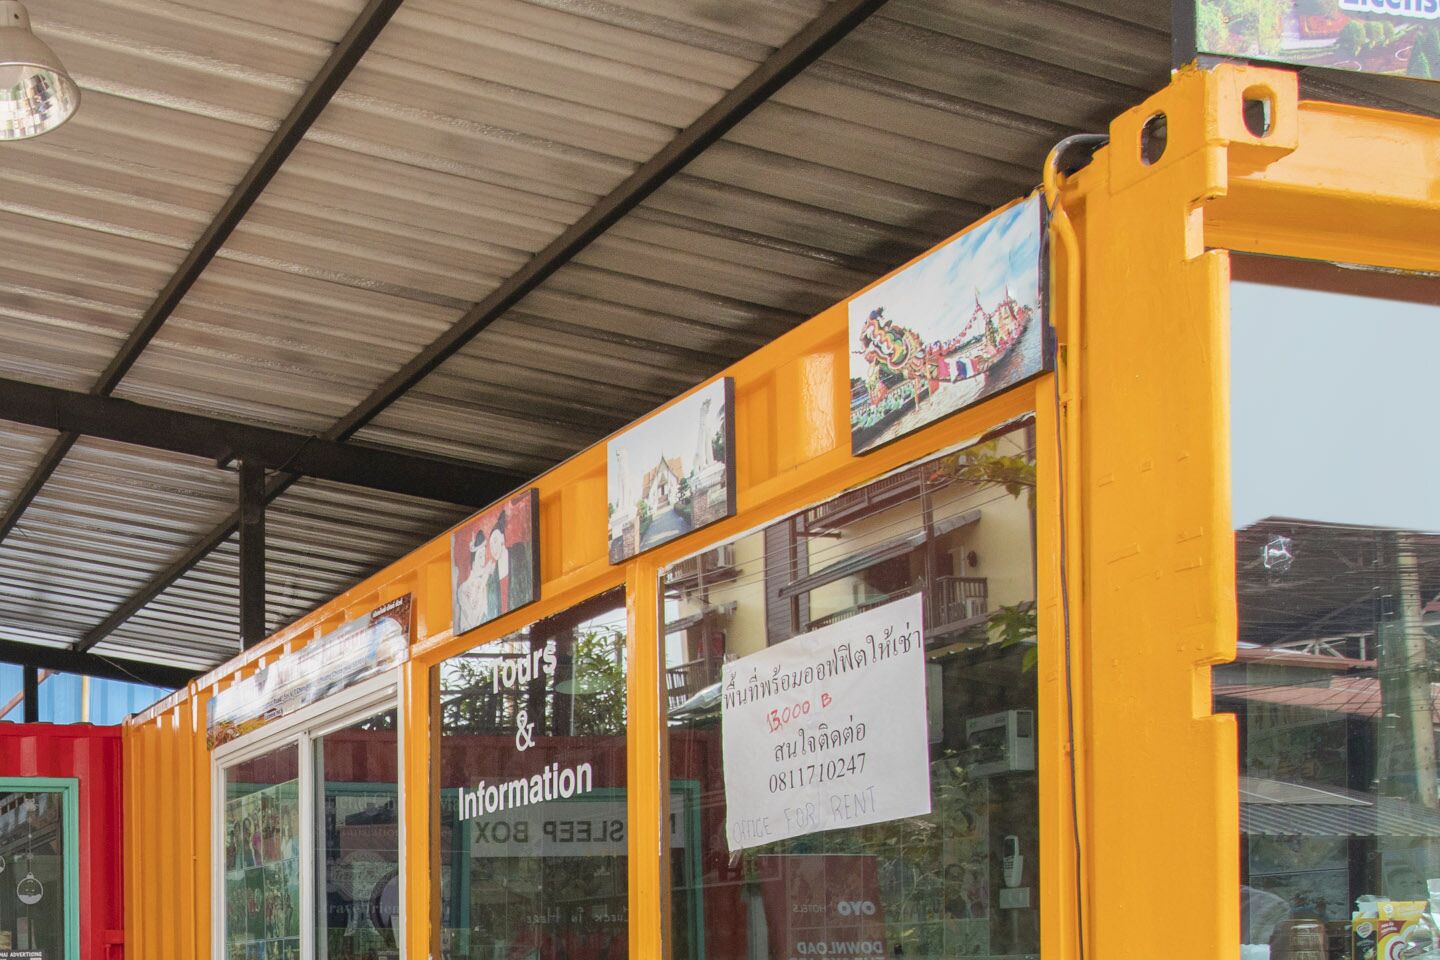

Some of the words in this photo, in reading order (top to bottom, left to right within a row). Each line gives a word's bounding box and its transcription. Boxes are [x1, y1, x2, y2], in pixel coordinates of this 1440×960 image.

[491, 640, 557, 694] Tours
[515, 711, 535, 751] &
[774, 715, 866, 762] สนใจติดต่อ
[459, 762, 592, 821] Information
[769, 753, 866, 793] 0811710247
[784, 802, 818, 831] FOR
[830, 785, 878, 822] RENT
